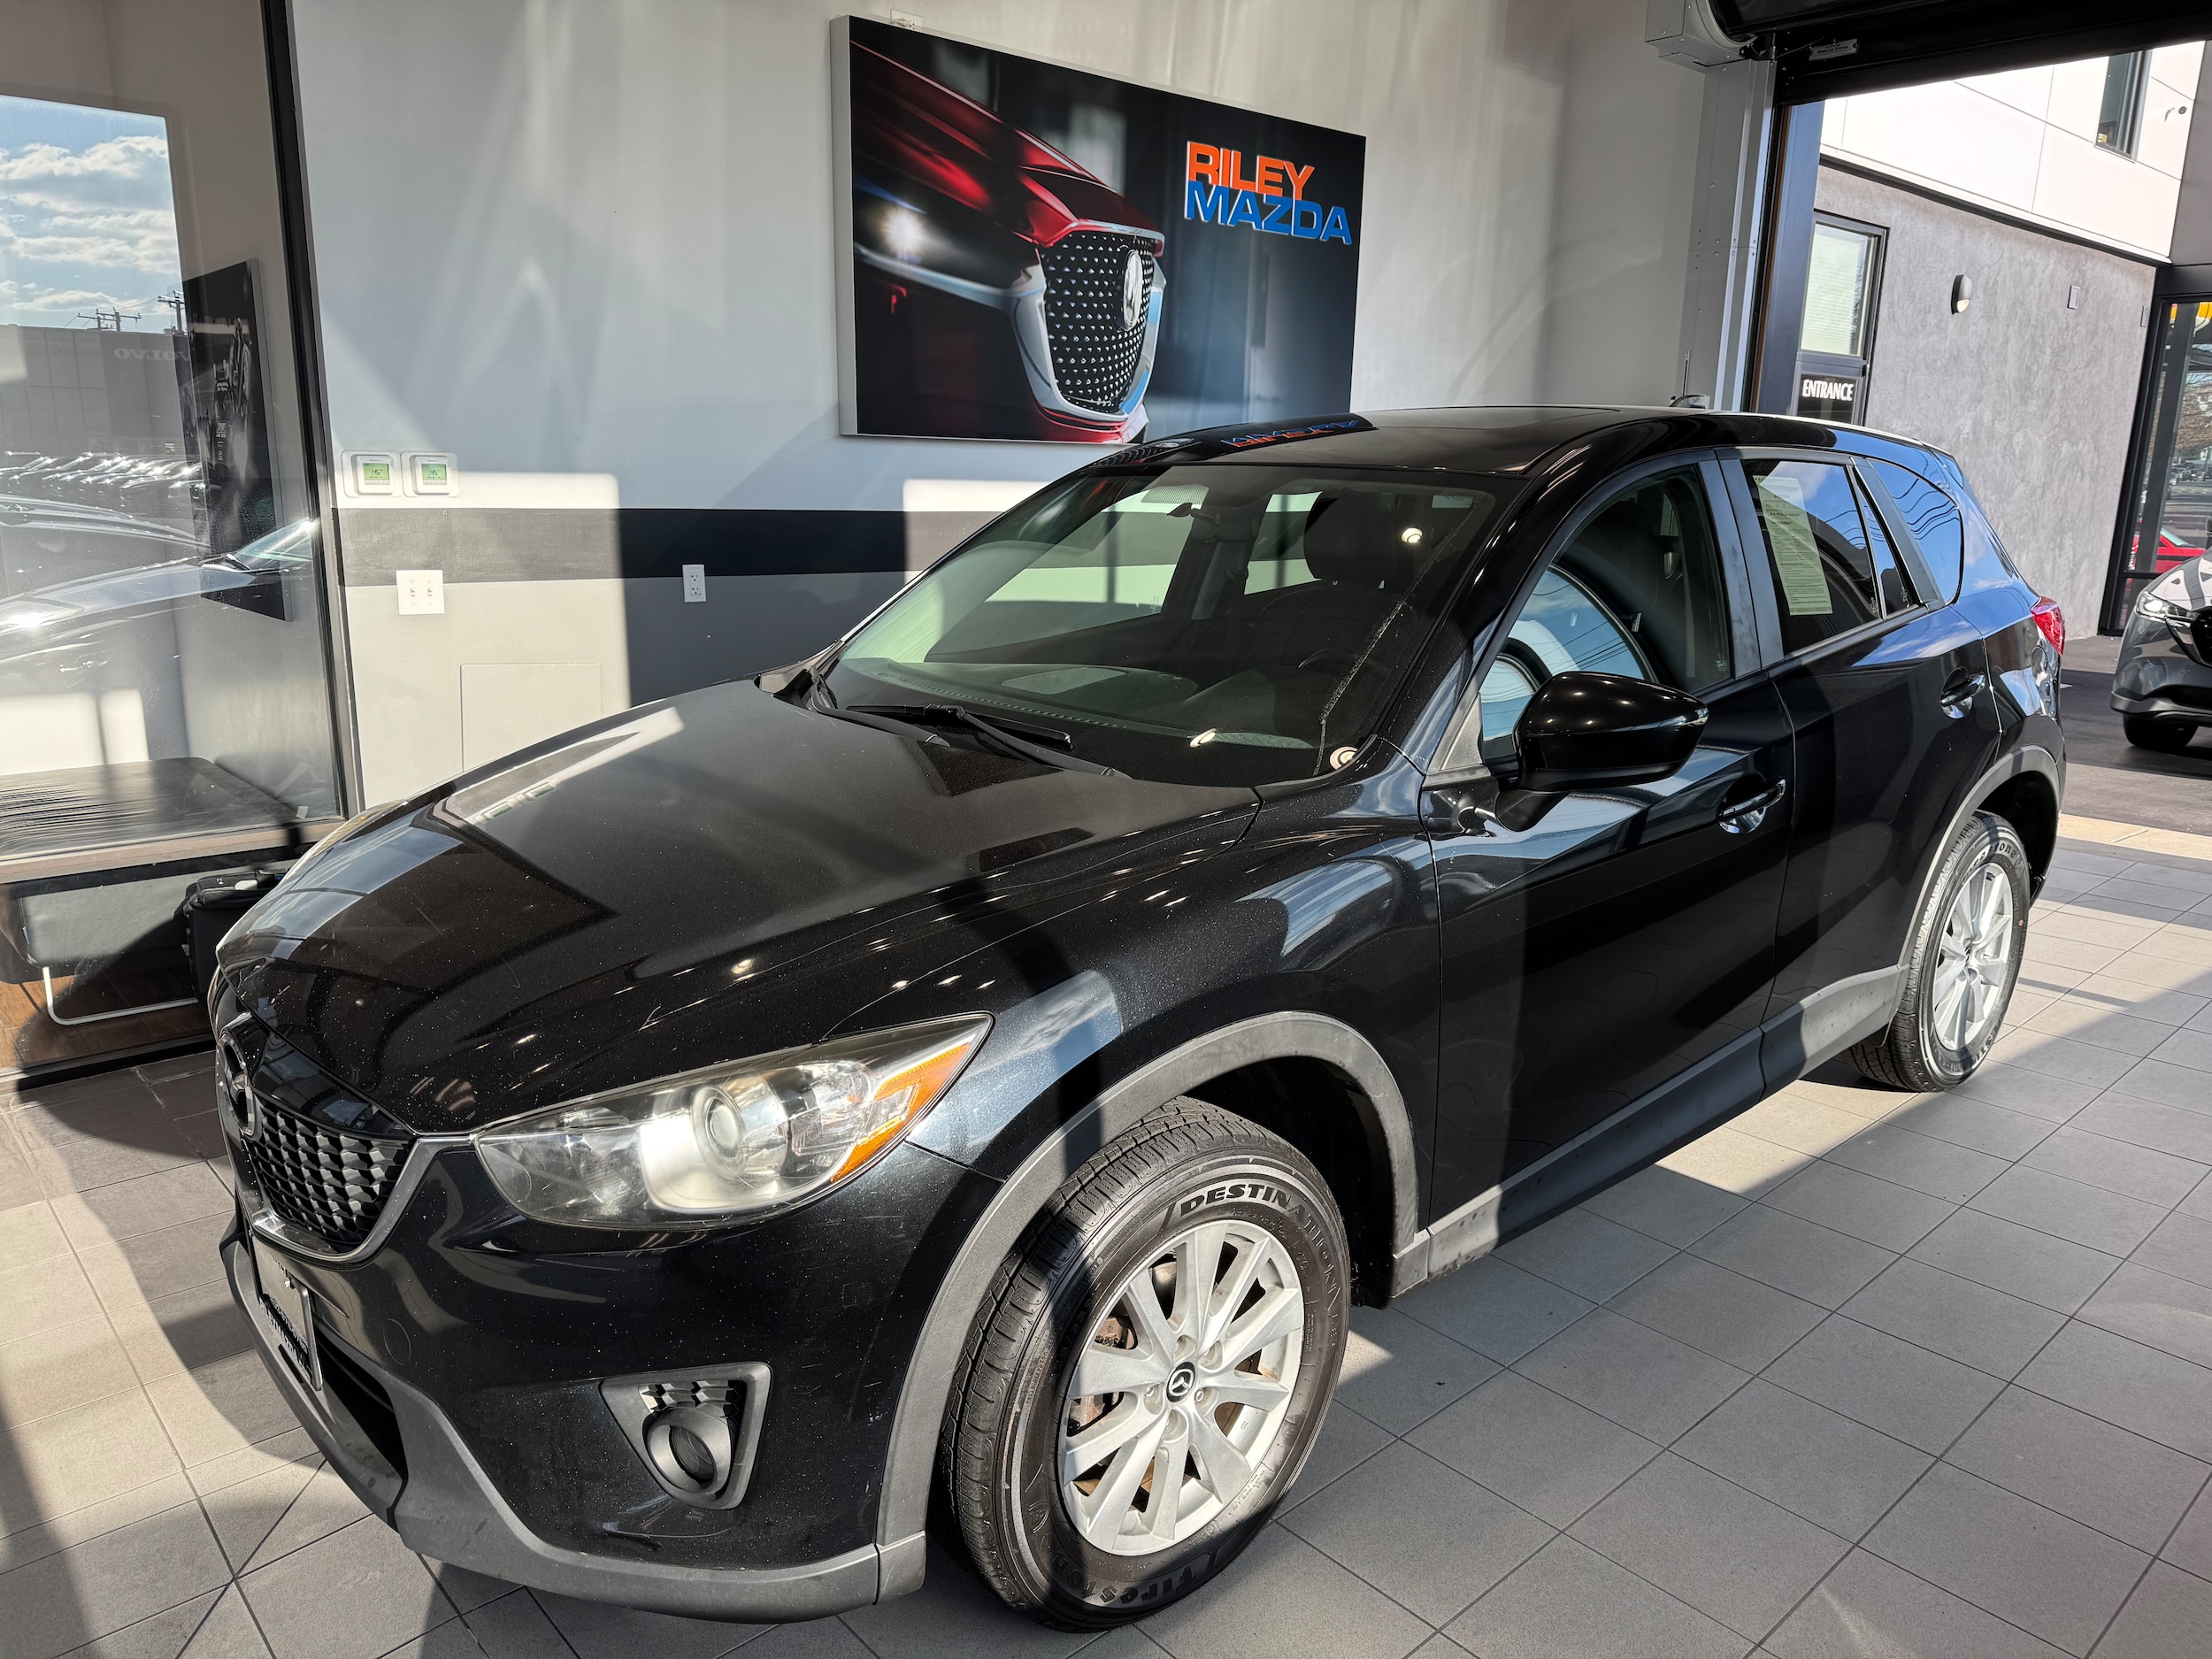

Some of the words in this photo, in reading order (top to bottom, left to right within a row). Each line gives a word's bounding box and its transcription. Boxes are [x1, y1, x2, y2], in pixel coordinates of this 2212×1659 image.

[1187, 141, 1316, 201] RILEY
[1184, 180, 1353, 246] MAZDA
[1801, 379, 1855, 402] ENTRANCE
[1179, 1183, 1339, 1294] DESTINATION
